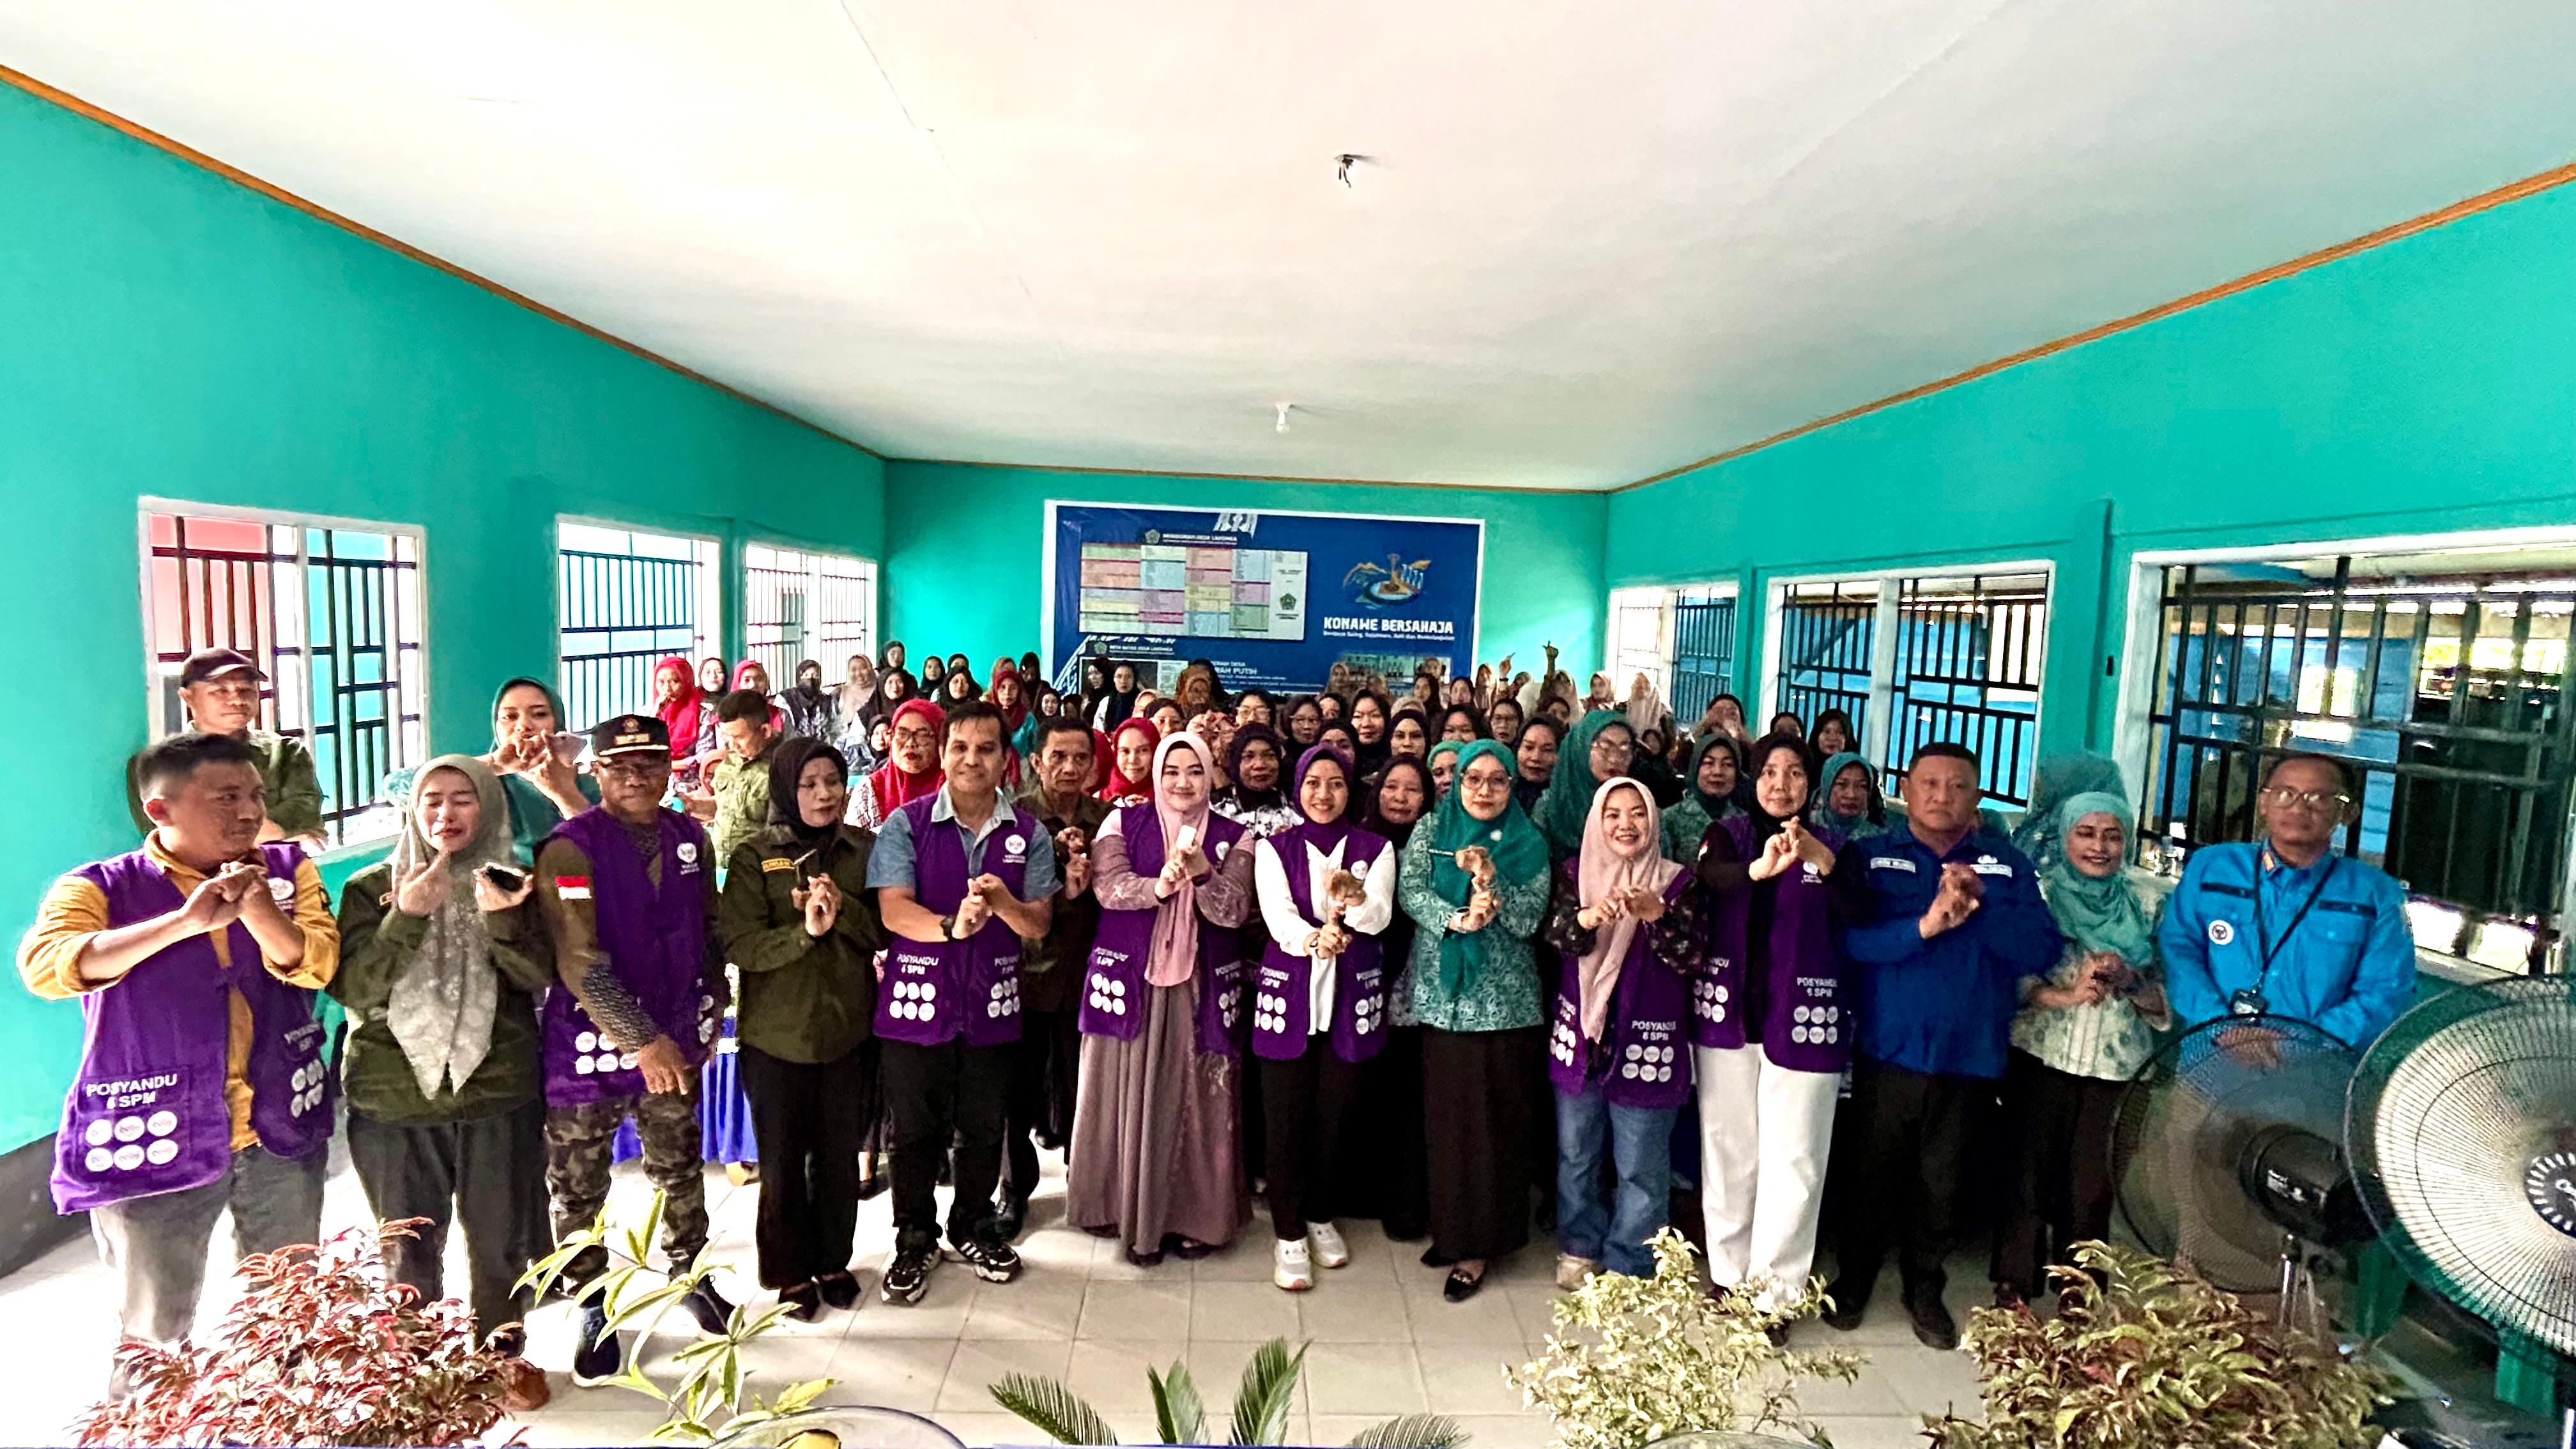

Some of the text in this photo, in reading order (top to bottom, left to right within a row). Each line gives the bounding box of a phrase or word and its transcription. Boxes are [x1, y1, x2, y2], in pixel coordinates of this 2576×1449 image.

[1324, 617, 1454, 634] KONAWE BERSAHAJA
[1233, 667, 1257, 675] PUTIH
[86, 1073, 178, 1098] POSYANDU
[119, 1091, 157, 1108] SPM
